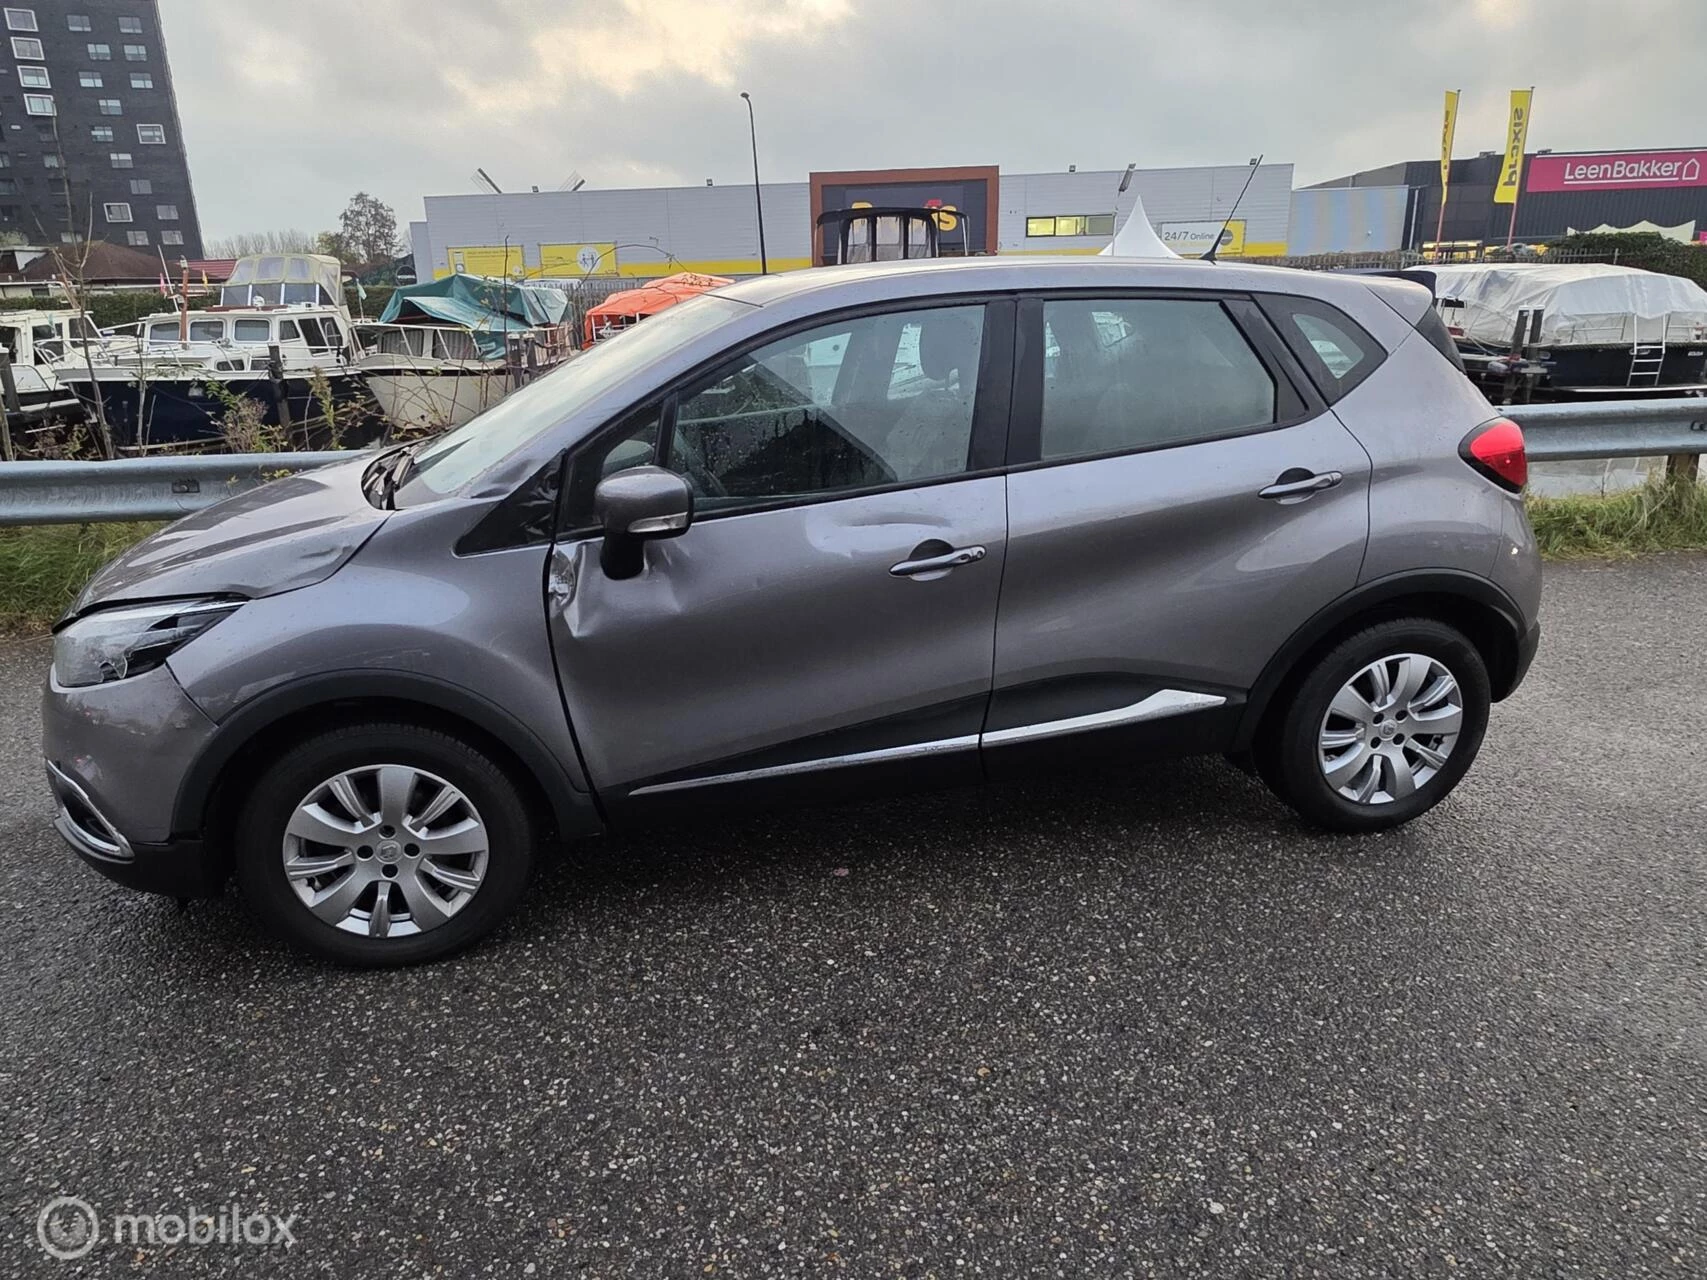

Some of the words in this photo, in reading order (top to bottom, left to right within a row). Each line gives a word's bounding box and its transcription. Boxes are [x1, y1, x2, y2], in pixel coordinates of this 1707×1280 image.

[1564, 159, 1682, 181] LeenBakker
[1164, 231, 1189, 241] 24/7
[1190, 231, 1215, 240] Online
